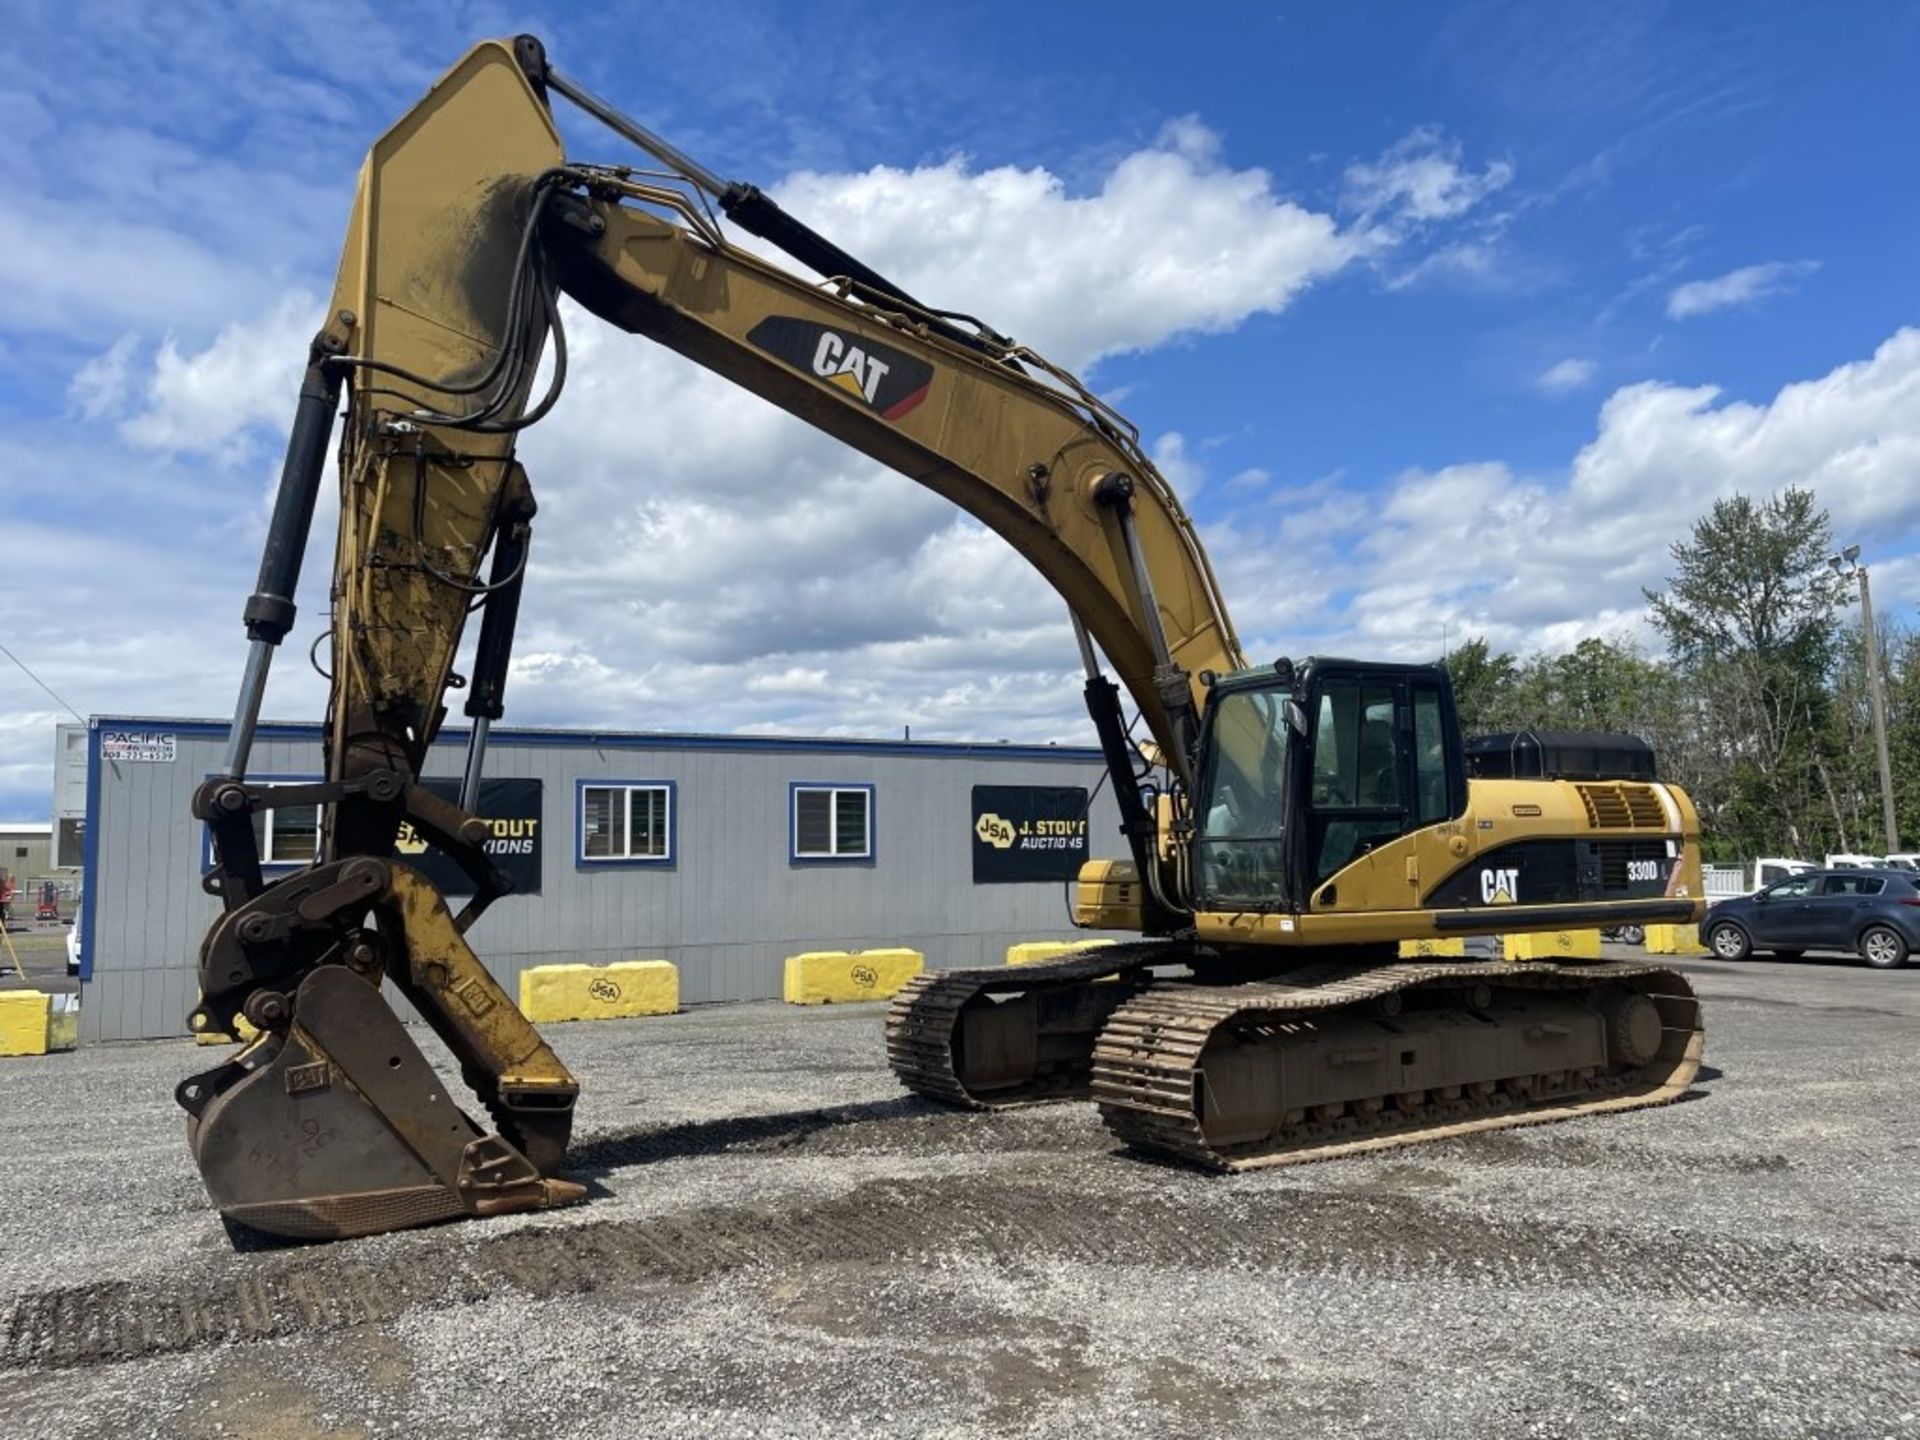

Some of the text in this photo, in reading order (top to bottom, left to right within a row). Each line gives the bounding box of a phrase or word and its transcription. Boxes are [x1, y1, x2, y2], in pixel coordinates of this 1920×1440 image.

[813, 331, 889, 404] CAT
[102, 732, 173, 745] PACIFIC
[980, 818, 1010, 841] JSA
[1019, 820, 1086, 835] J. STOUT
[1627, 861, 1658, 881] 330D
[1480, 869, 1519, 904] CAT
[592, 982, 616, 998] JSA
